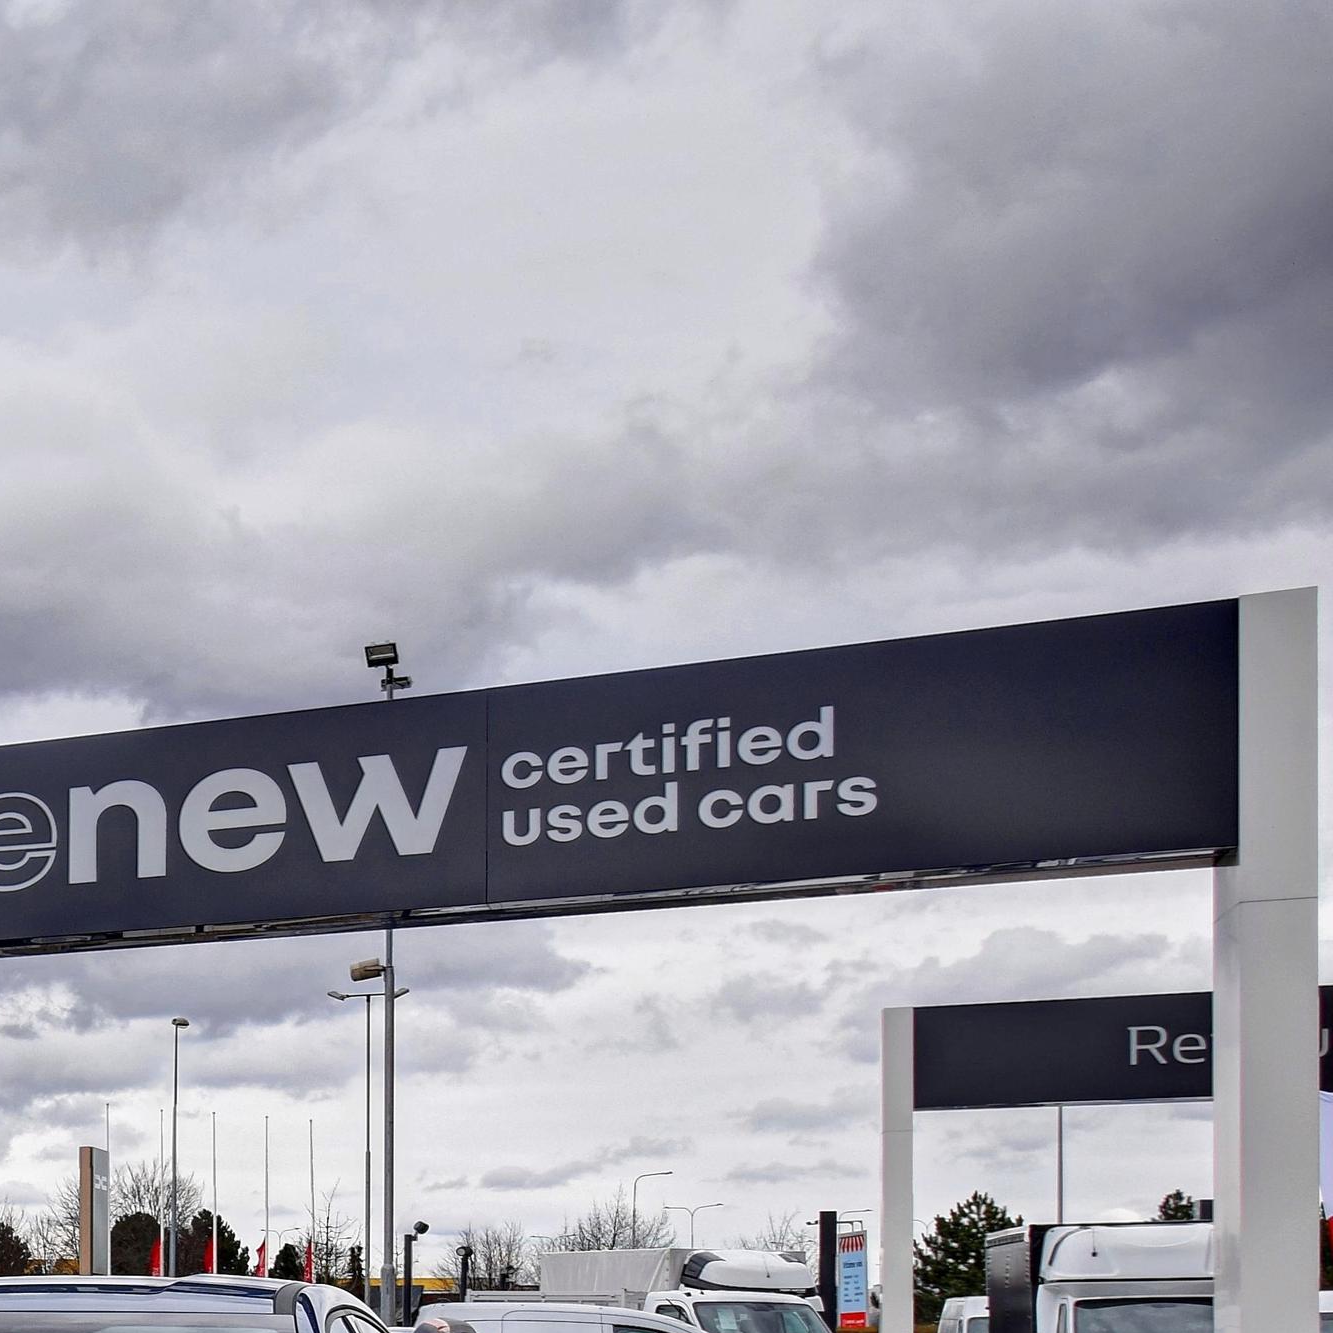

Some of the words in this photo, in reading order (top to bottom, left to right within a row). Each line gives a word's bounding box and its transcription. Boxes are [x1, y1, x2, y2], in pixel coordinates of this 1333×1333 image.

[500, 705, 836, 791] certified
[500, 791, 680, 848] used
[696, 775, 878, 827] cars
